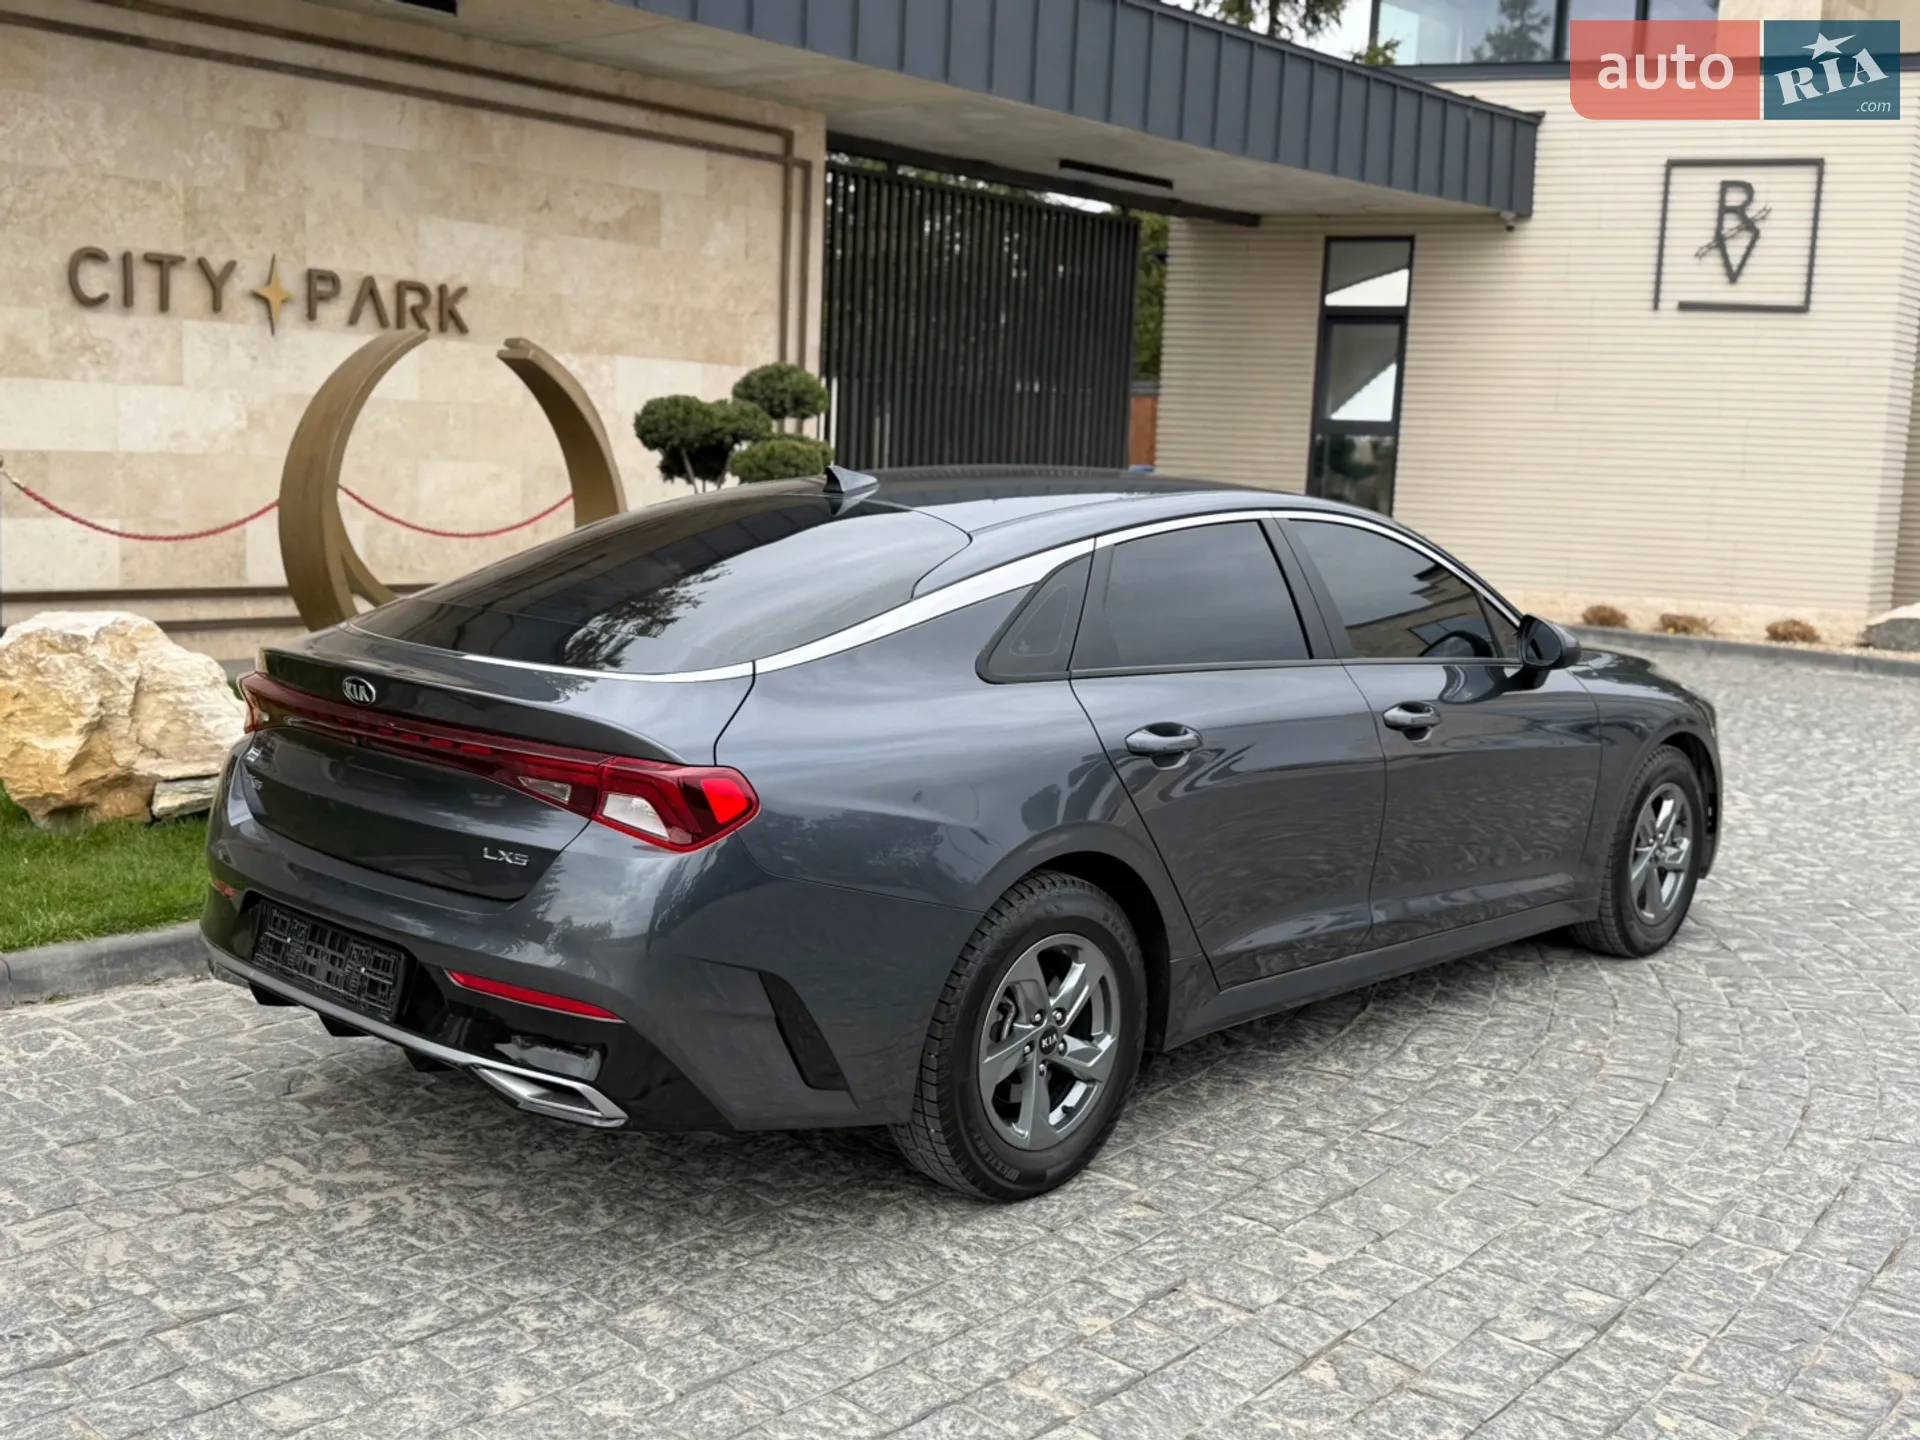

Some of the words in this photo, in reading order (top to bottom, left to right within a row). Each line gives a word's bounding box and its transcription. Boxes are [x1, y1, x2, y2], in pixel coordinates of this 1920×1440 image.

[67, 246, 238, 314] CITY
[306, 268, 470, 334] PARK
[344, 680, 371, 703] KIA
[483, 847, 529, 867] LXS
[1041, 1034, 1058, 1048] KIA
